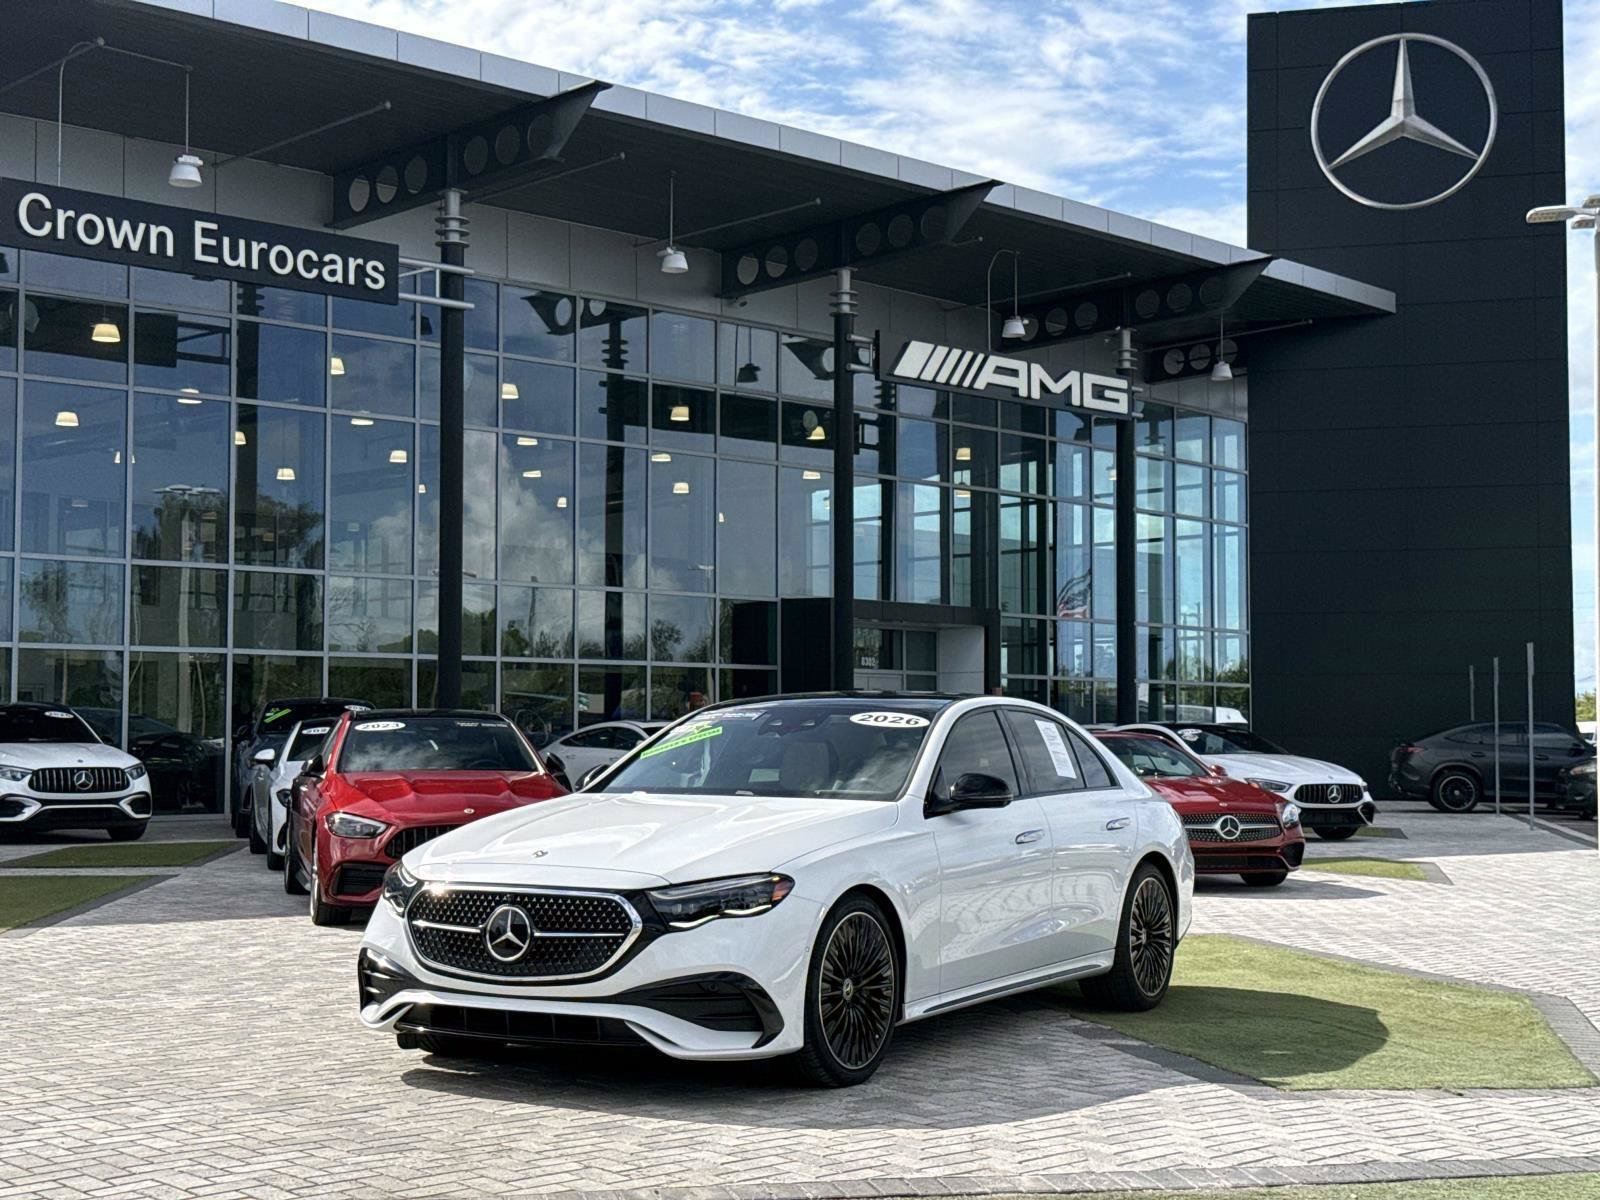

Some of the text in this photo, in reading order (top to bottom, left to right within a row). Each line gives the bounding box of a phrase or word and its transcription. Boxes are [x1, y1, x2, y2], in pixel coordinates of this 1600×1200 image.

[18, 192, 387, 291] Crown Eurocars
[972, 354, 1129, 415] AMG
[857, 713, 921, 726] 2026
